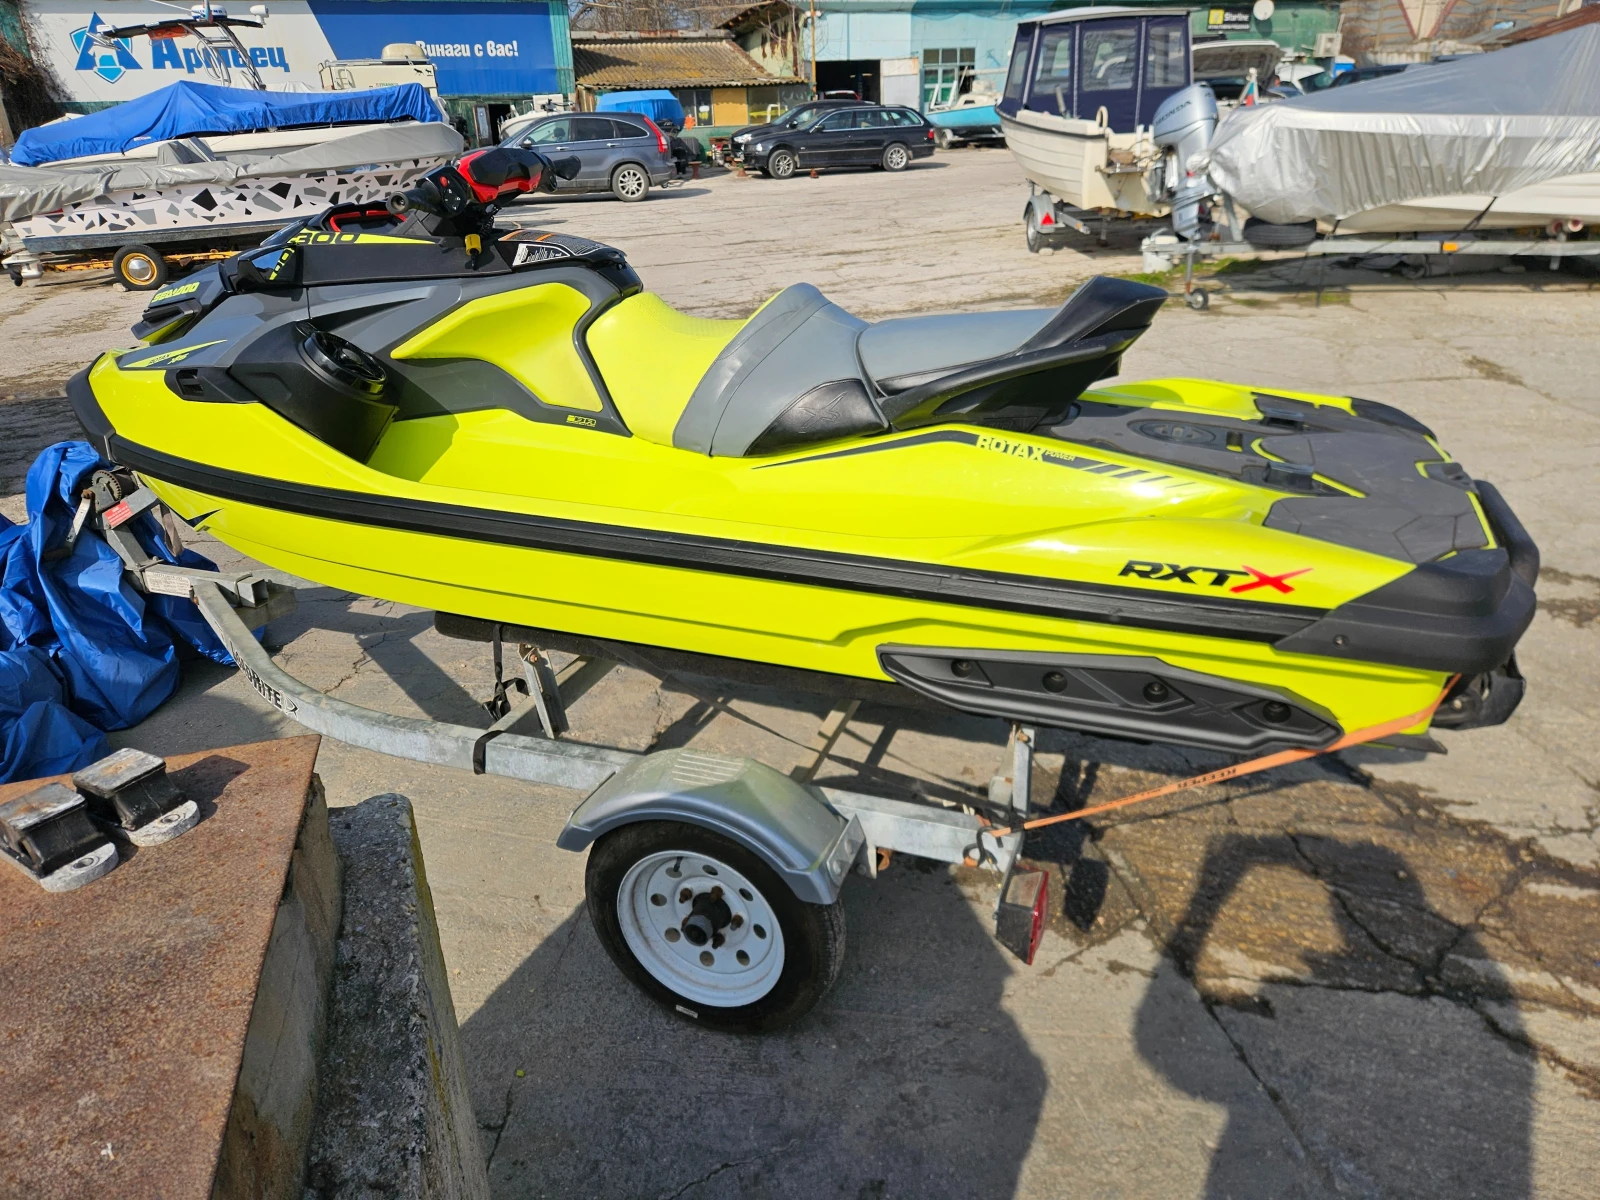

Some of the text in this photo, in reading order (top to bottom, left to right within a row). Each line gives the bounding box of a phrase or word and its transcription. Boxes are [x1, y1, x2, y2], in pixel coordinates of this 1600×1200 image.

[415, 40, 471, 58] Винаги
[474, 43, 484, 58] с
[1155, 100, 1193, 126] HONDA
[296, 231, 359, 245] 300
[975, 434, 1044, 462] ROTAX
